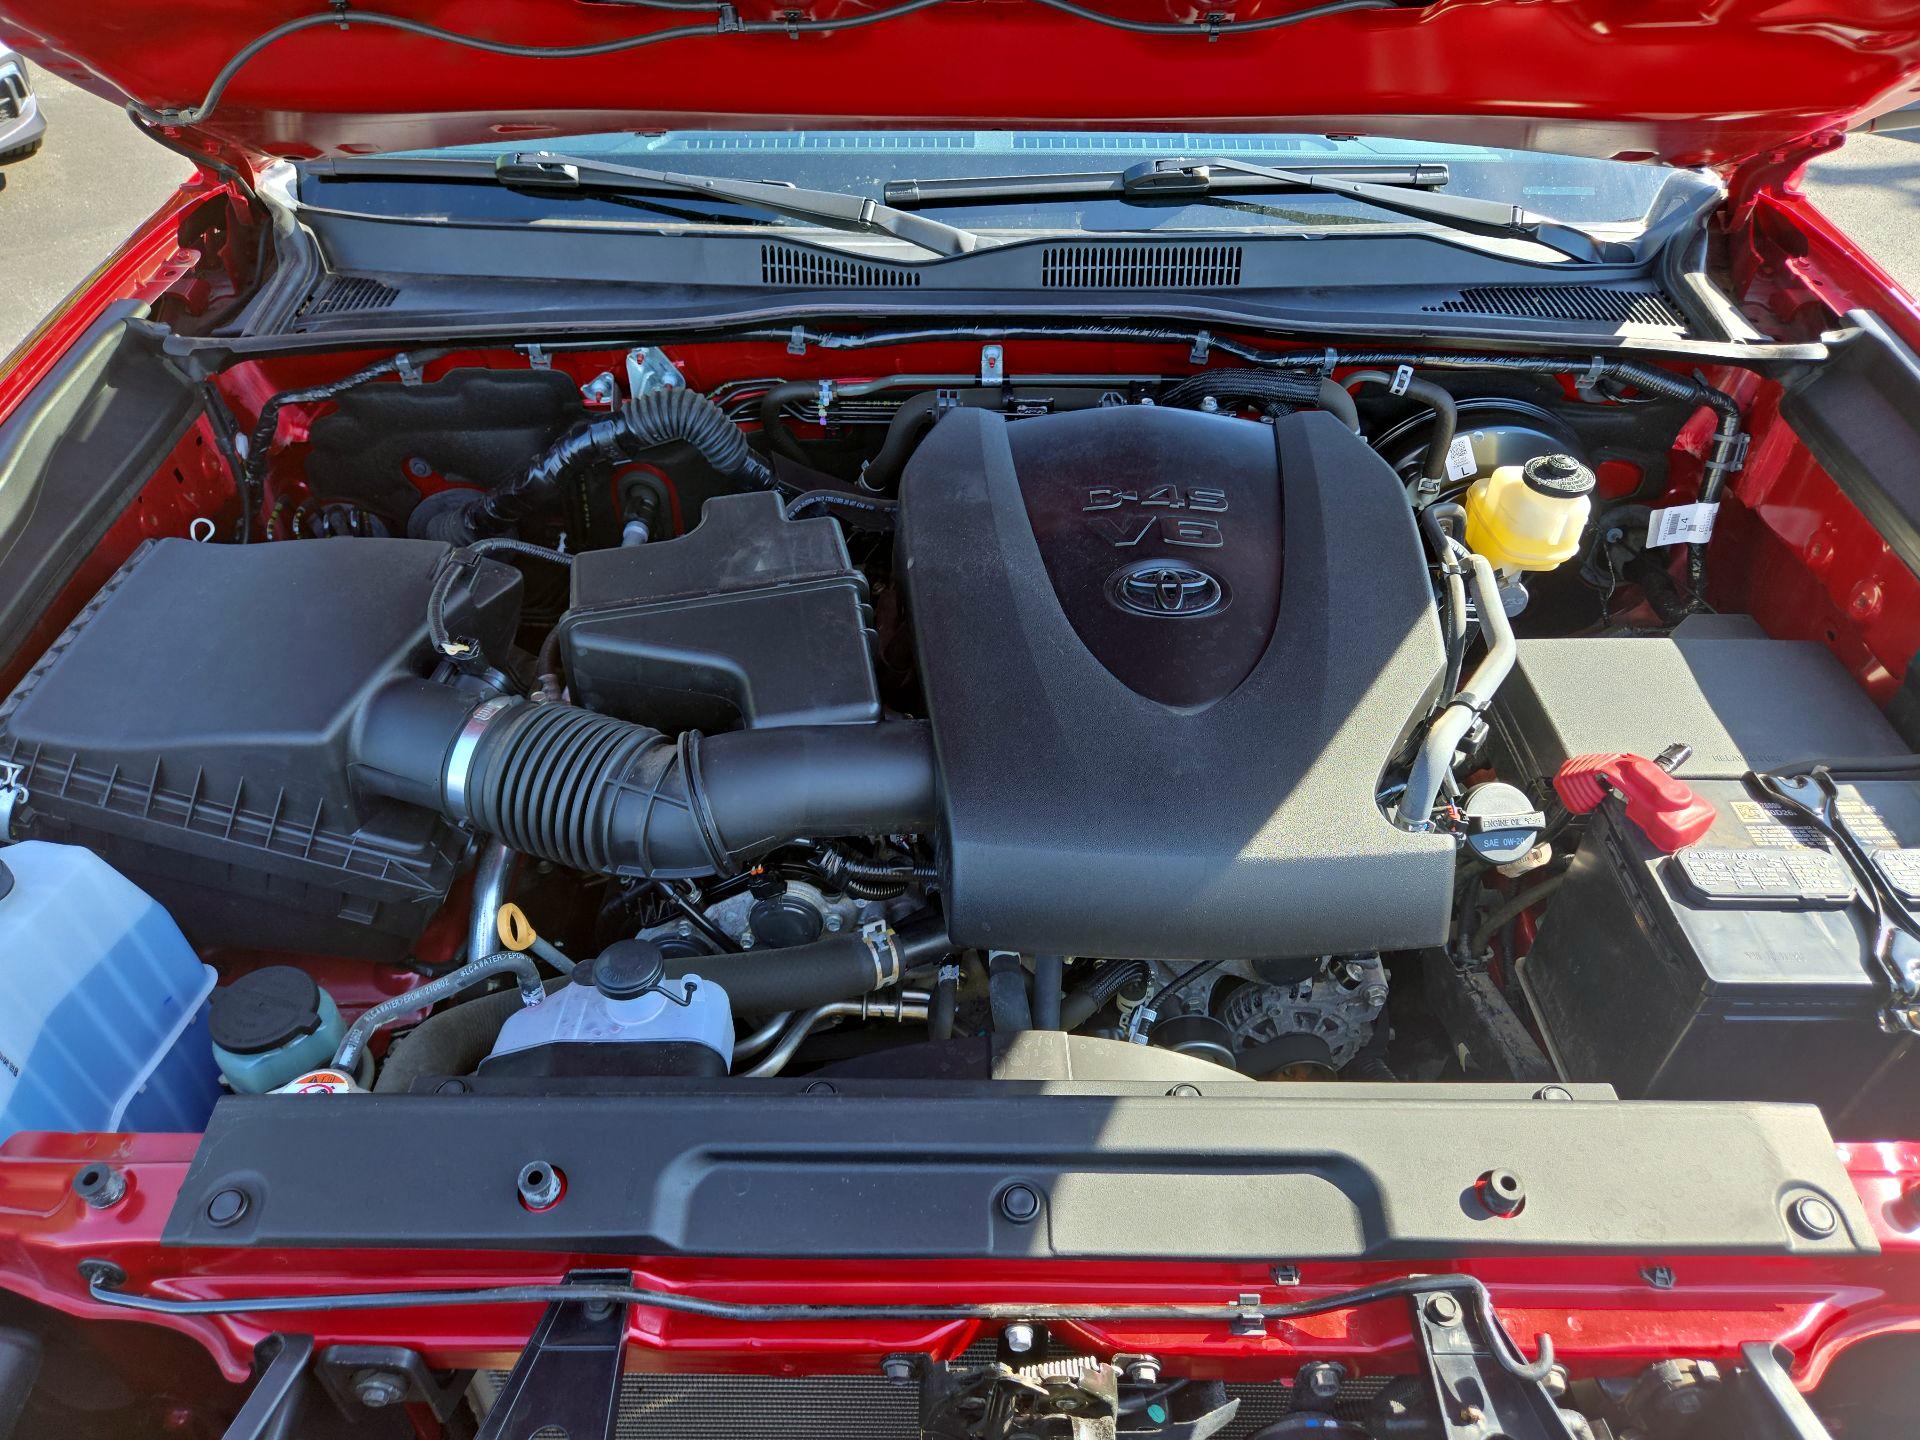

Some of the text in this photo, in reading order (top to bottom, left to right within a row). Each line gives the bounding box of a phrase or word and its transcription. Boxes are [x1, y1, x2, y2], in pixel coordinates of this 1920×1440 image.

[1083, 484, 1229, 512] D-4S
[1087, 514, 1224, 548] V6
[1483, 818, 1509, 828] ENGINE
[1483, 836, 1526, 848] SAE 0W-20
